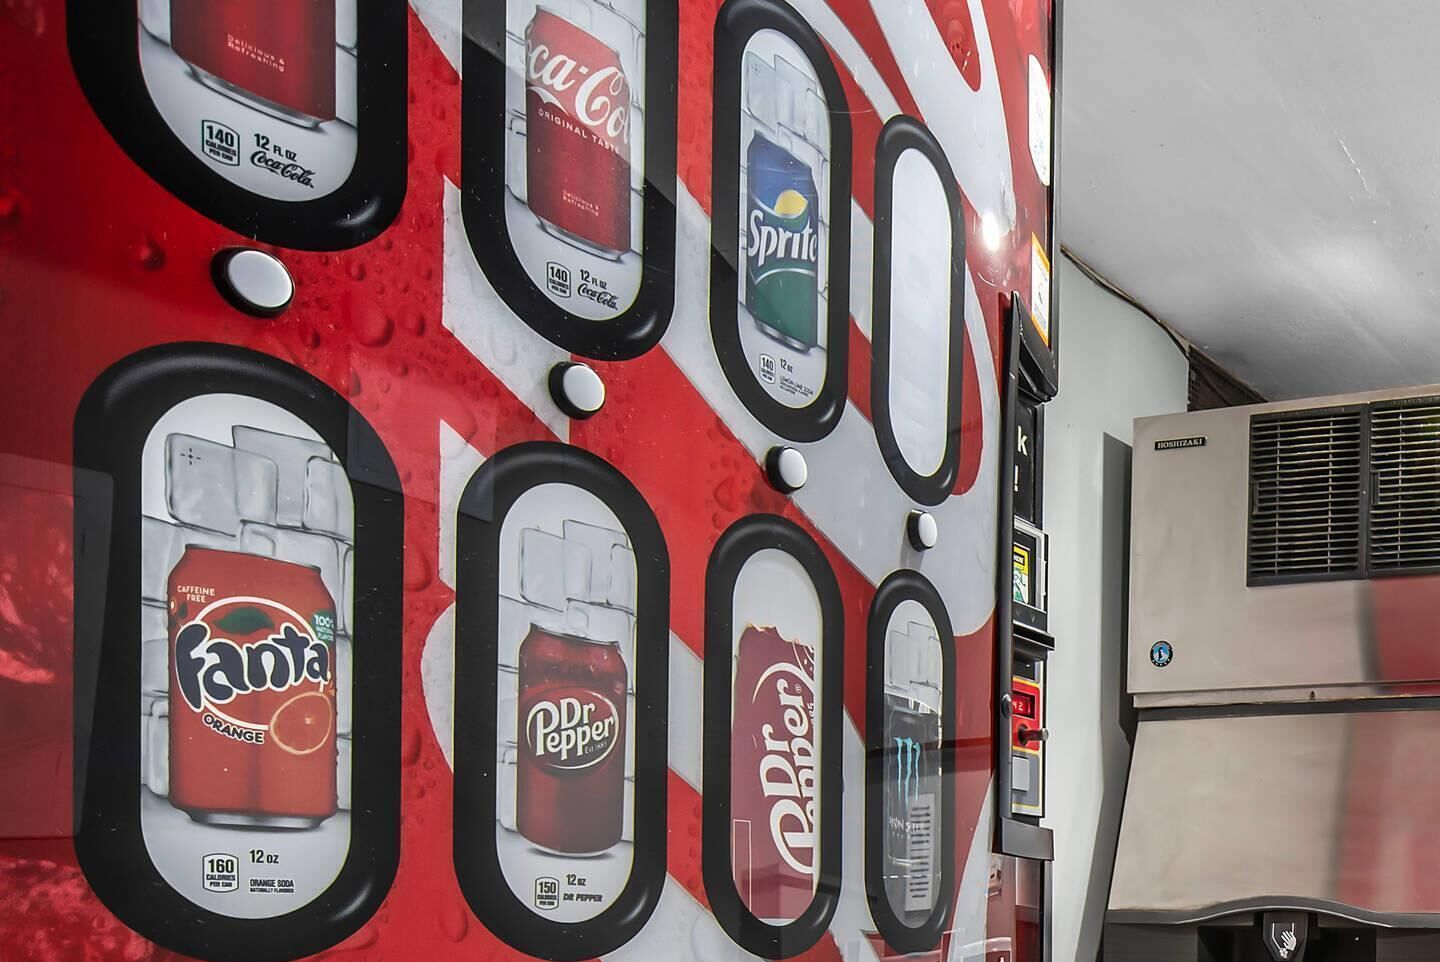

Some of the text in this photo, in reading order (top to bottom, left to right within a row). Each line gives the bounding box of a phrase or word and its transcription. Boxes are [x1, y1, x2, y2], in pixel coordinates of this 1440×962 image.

[227, 34, 276, 60] Delicious
[227, 41, 285, 73] Refreshing
[538, 107, 588, 140] ORIGINAL
[206, 125, 235, 148] 140
[254, 133, 271, 151] 12
[250, 150, 316, 188] Coca-Cola
[550, 267, 568, 283] 140
[580, 269, 590, 283] 12
[577, 283, 619, 311] Coca-Cola
[762, 357, 773, 371] 140
[780, 358, 787, 370] 12
[1157, 438, 1203, 449] HOSHIZAKI
[177, 585, 215, 597] CAFFEINE
[186, 594, 206, 603] FREE
[560, 697, 596, 729] Dr
[203, 713, 265, 745] ORANGE
[527, 701, 615, 761] Pepper
[760, 723, 802, 798] Dr
[249, 849, 264, 864] 12
[208, 859, 234, 873] 160
[250, 879, 294, 888] ORANGE SODA
[566, 874, 577, 885] 12
[539, 882, 556, 894] 150
[563, 893, 603, 902] DR PEPPER
